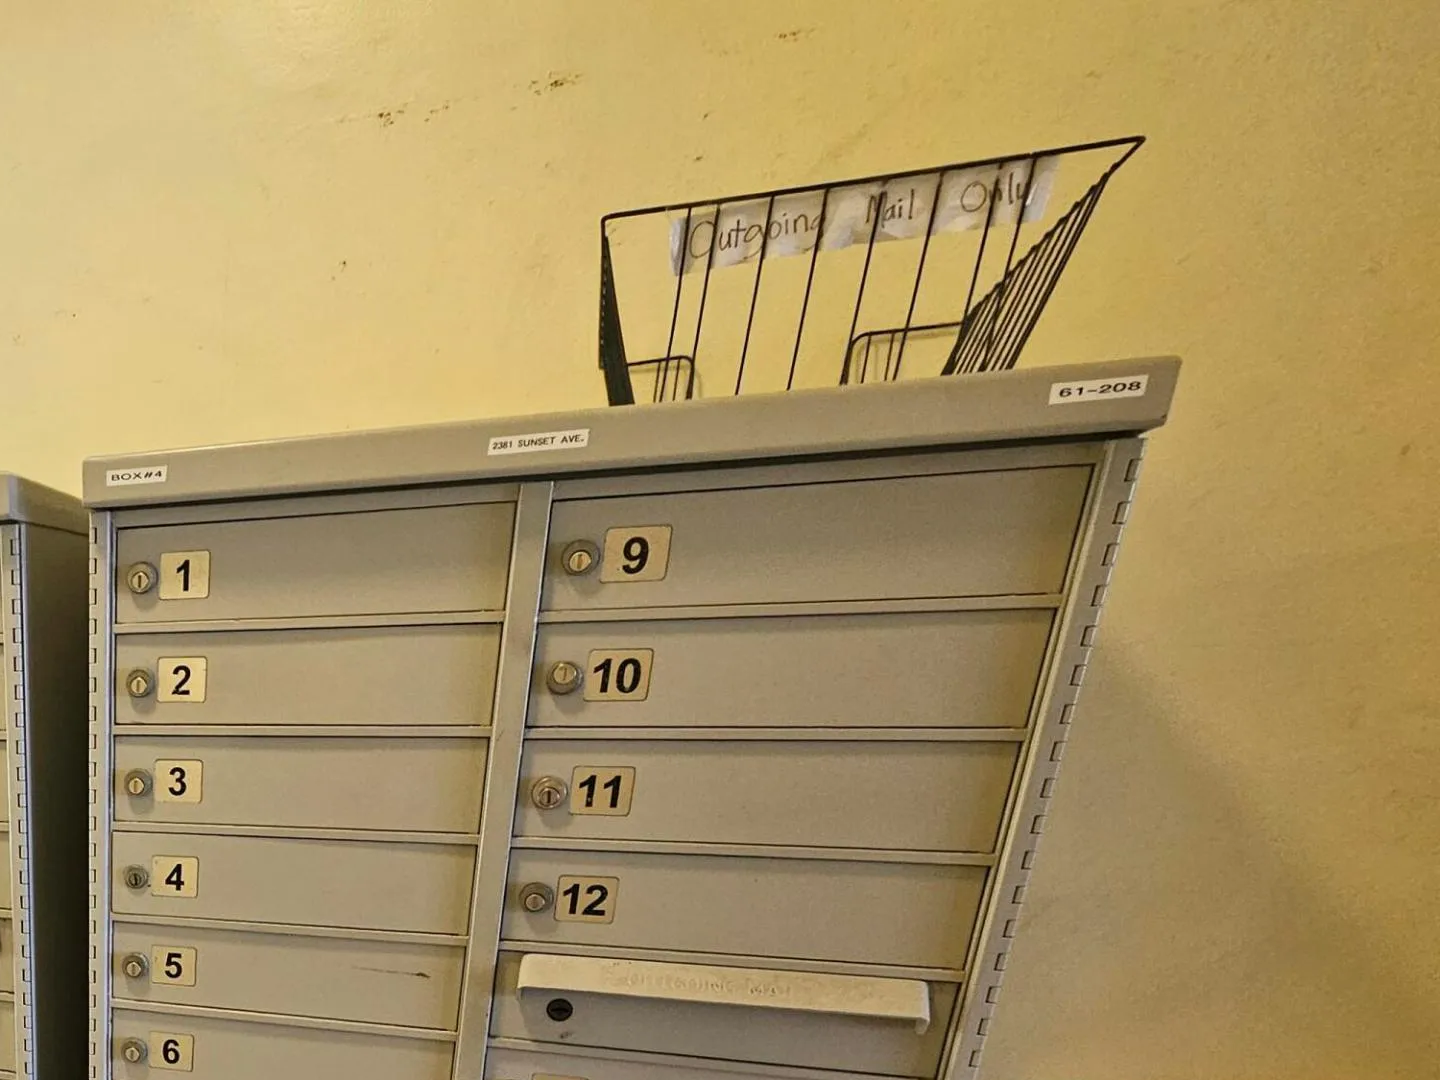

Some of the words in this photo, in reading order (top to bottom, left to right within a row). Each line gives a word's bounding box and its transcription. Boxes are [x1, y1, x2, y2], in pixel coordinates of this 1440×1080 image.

[866, 188, 915, 228] Mail
[1059, 381, 1142, 398] 61-208
[518, 436, 557, 449] SUNSET
[560, 434, 585, 445] AVE.
[623, 537, 648, 574] 9
[177, 560, 189, 591] 1
[172, 666, 190, 695] 2
[594, 658, 641, 693] 10
[169, 767, 186, 796] 3
[579, 775, 621, 808] 11
[165, 864, 184, 890] 4
[564, 884, 608, 916] 12
[165, 953, 182, 978] 5
[163, 1040, 179, 1064] 6
